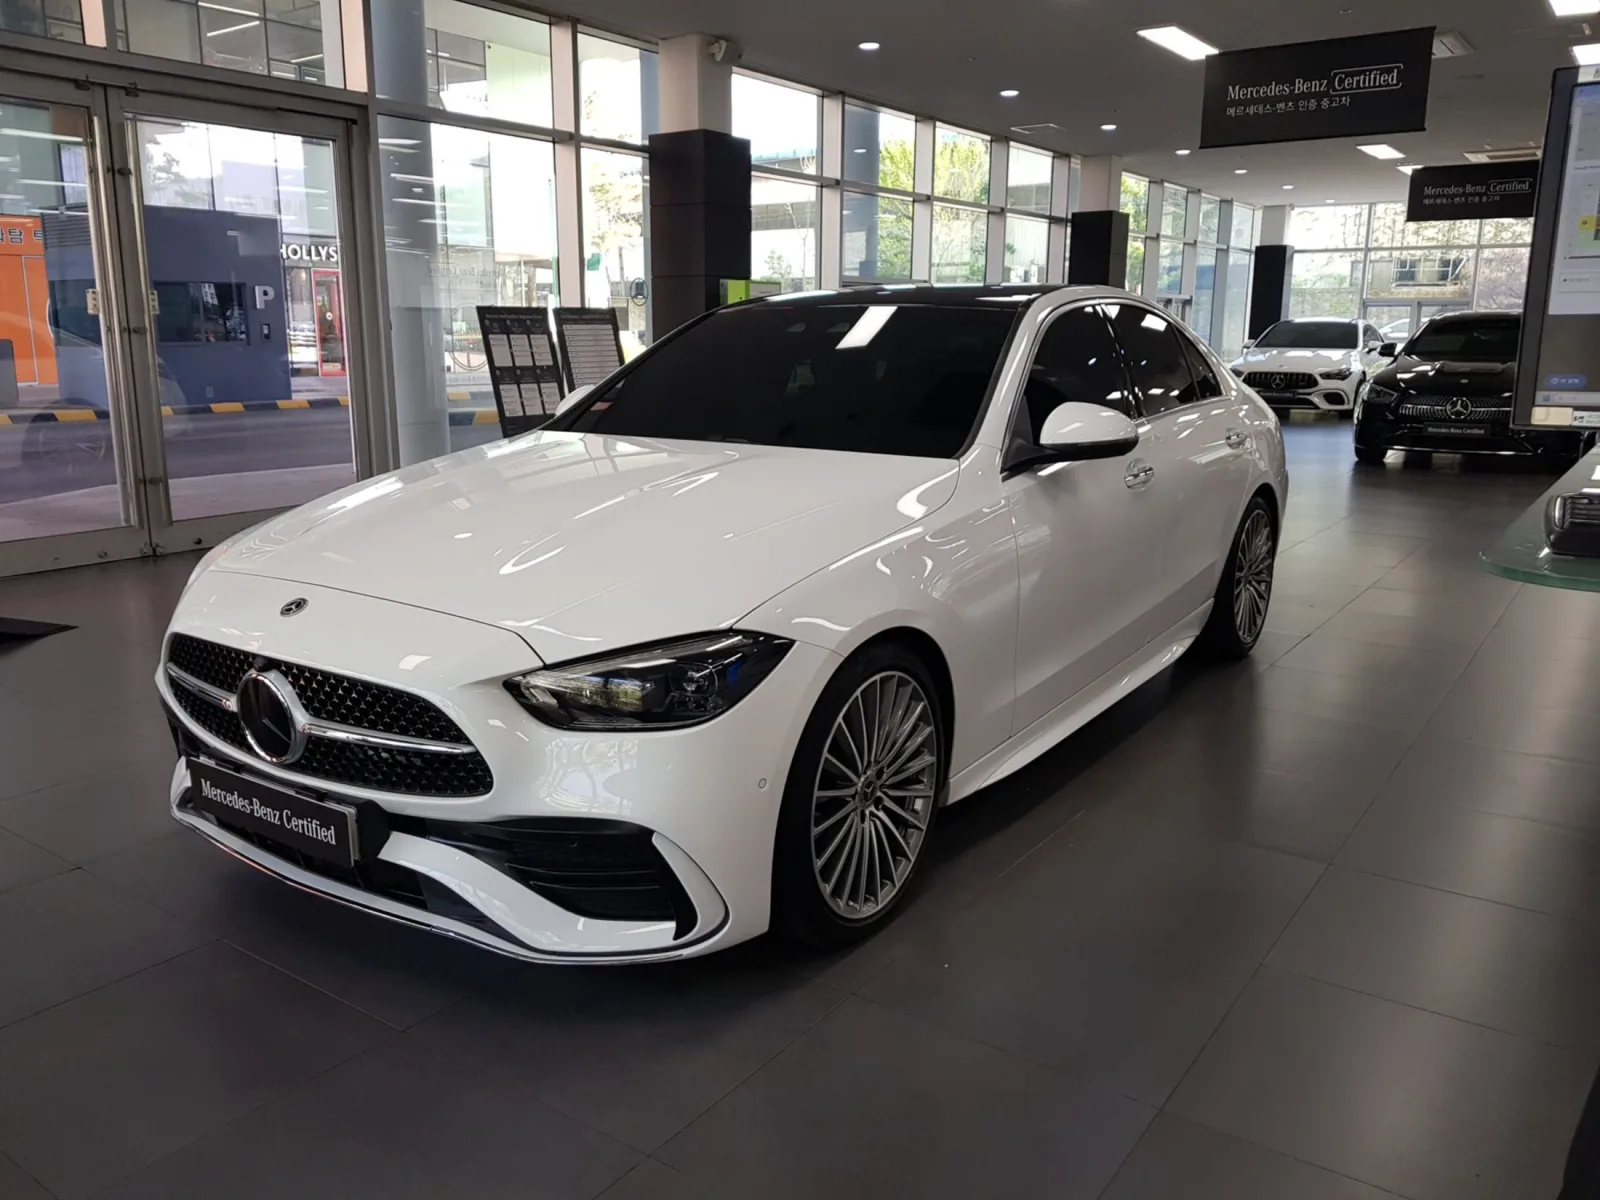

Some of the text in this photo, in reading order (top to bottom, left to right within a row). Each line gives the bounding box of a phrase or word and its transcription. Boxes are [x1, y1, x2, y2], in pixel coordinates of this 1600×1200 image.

[1226, 68, 1398, 101] Mercedes-Benz Certified
[1226, 95, 1351, 117] 메르세데스-벤츠 인증 중고차
[1423, 181, 1530, 196] Mercedes-Benz Certified
[280, 243, 338, 261] HOLLYS
[255, 285, 275, 309] P
[200, 778, 336, 846] Mercedes-Benz Certified
